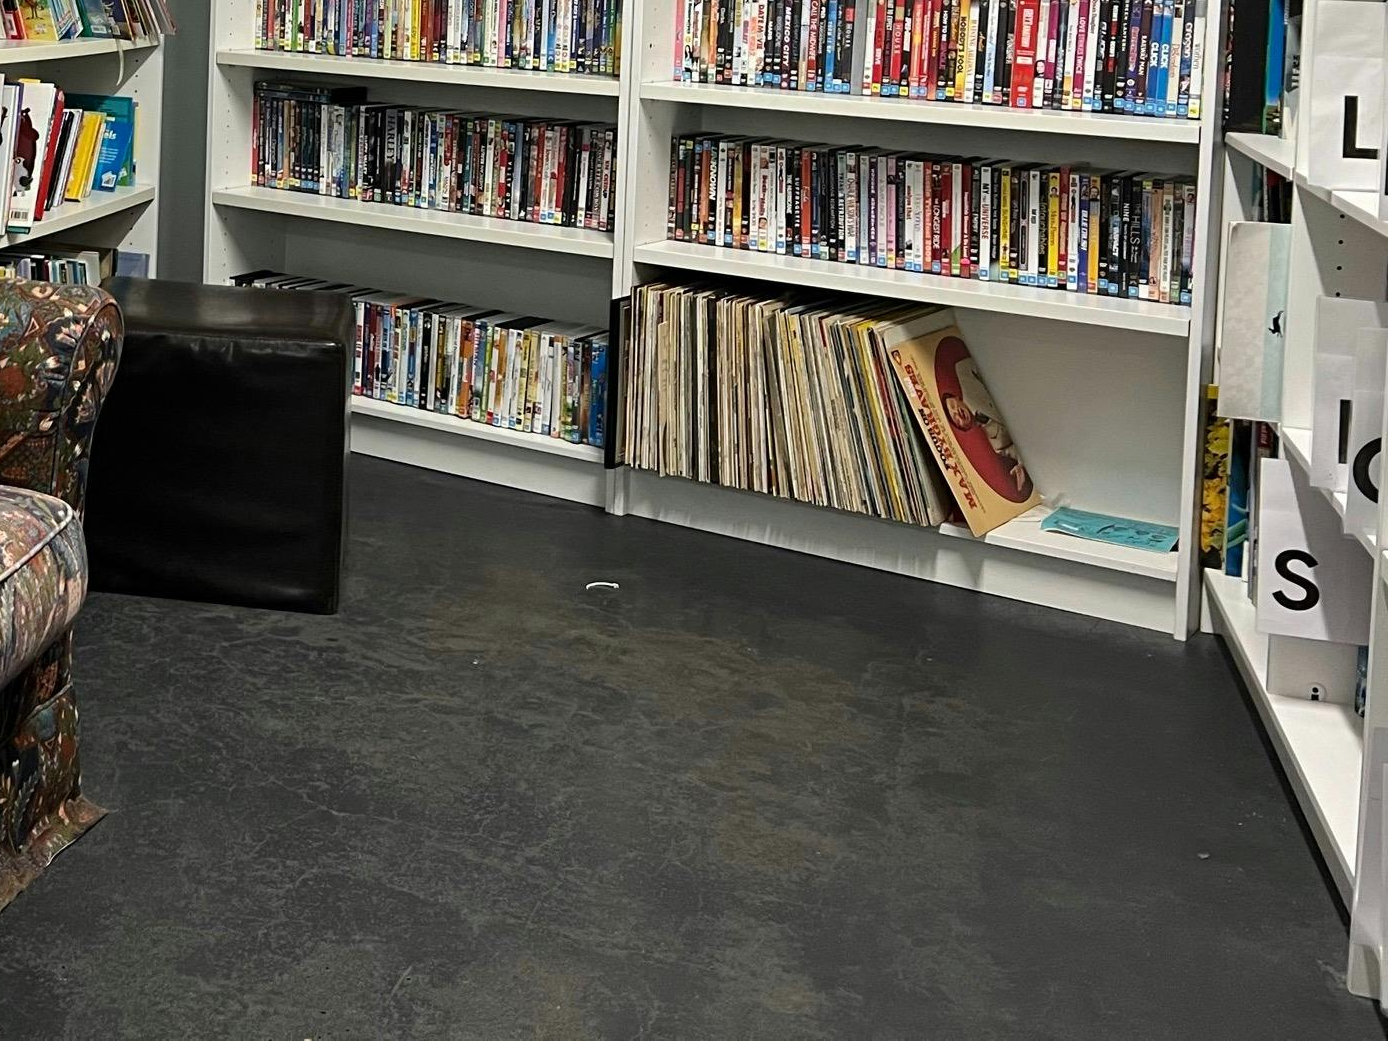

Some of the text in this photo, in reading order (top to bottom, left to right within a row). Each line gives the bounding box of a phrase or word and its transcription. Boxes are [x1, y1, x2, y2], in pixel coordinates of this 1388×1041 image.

[782, 6, 792, 67] MEXICO CITY
[809, 31, 817, 60] MIDWIFE
[810, 17, 818, 29] THE
[894, 24, 902, 54] HOUSE
[957, 16, 967, 74] NOBODY'S FOOL
[1150, 42, 1158, 67] CLICK
[1161, 43, 1169, 68] CLICK
[386, 115, 396, 160] HARLEY
[1342, 95, 1380, 159] L
[709, 146, 717, 200] UNKNOWN
[981, 182, 990, 239] MY UNIVERSE
[1130, 215, 1140, 244] HILLS
[932, 234, 940, 248] RIDE
[1112, 227, 1120, 257] IMPACT
[903, 363, 978, 510] MAX BYGRAVES
[918, 408, 951, 471] FOCUS ON
[1272, 549, 1320, 611] S
